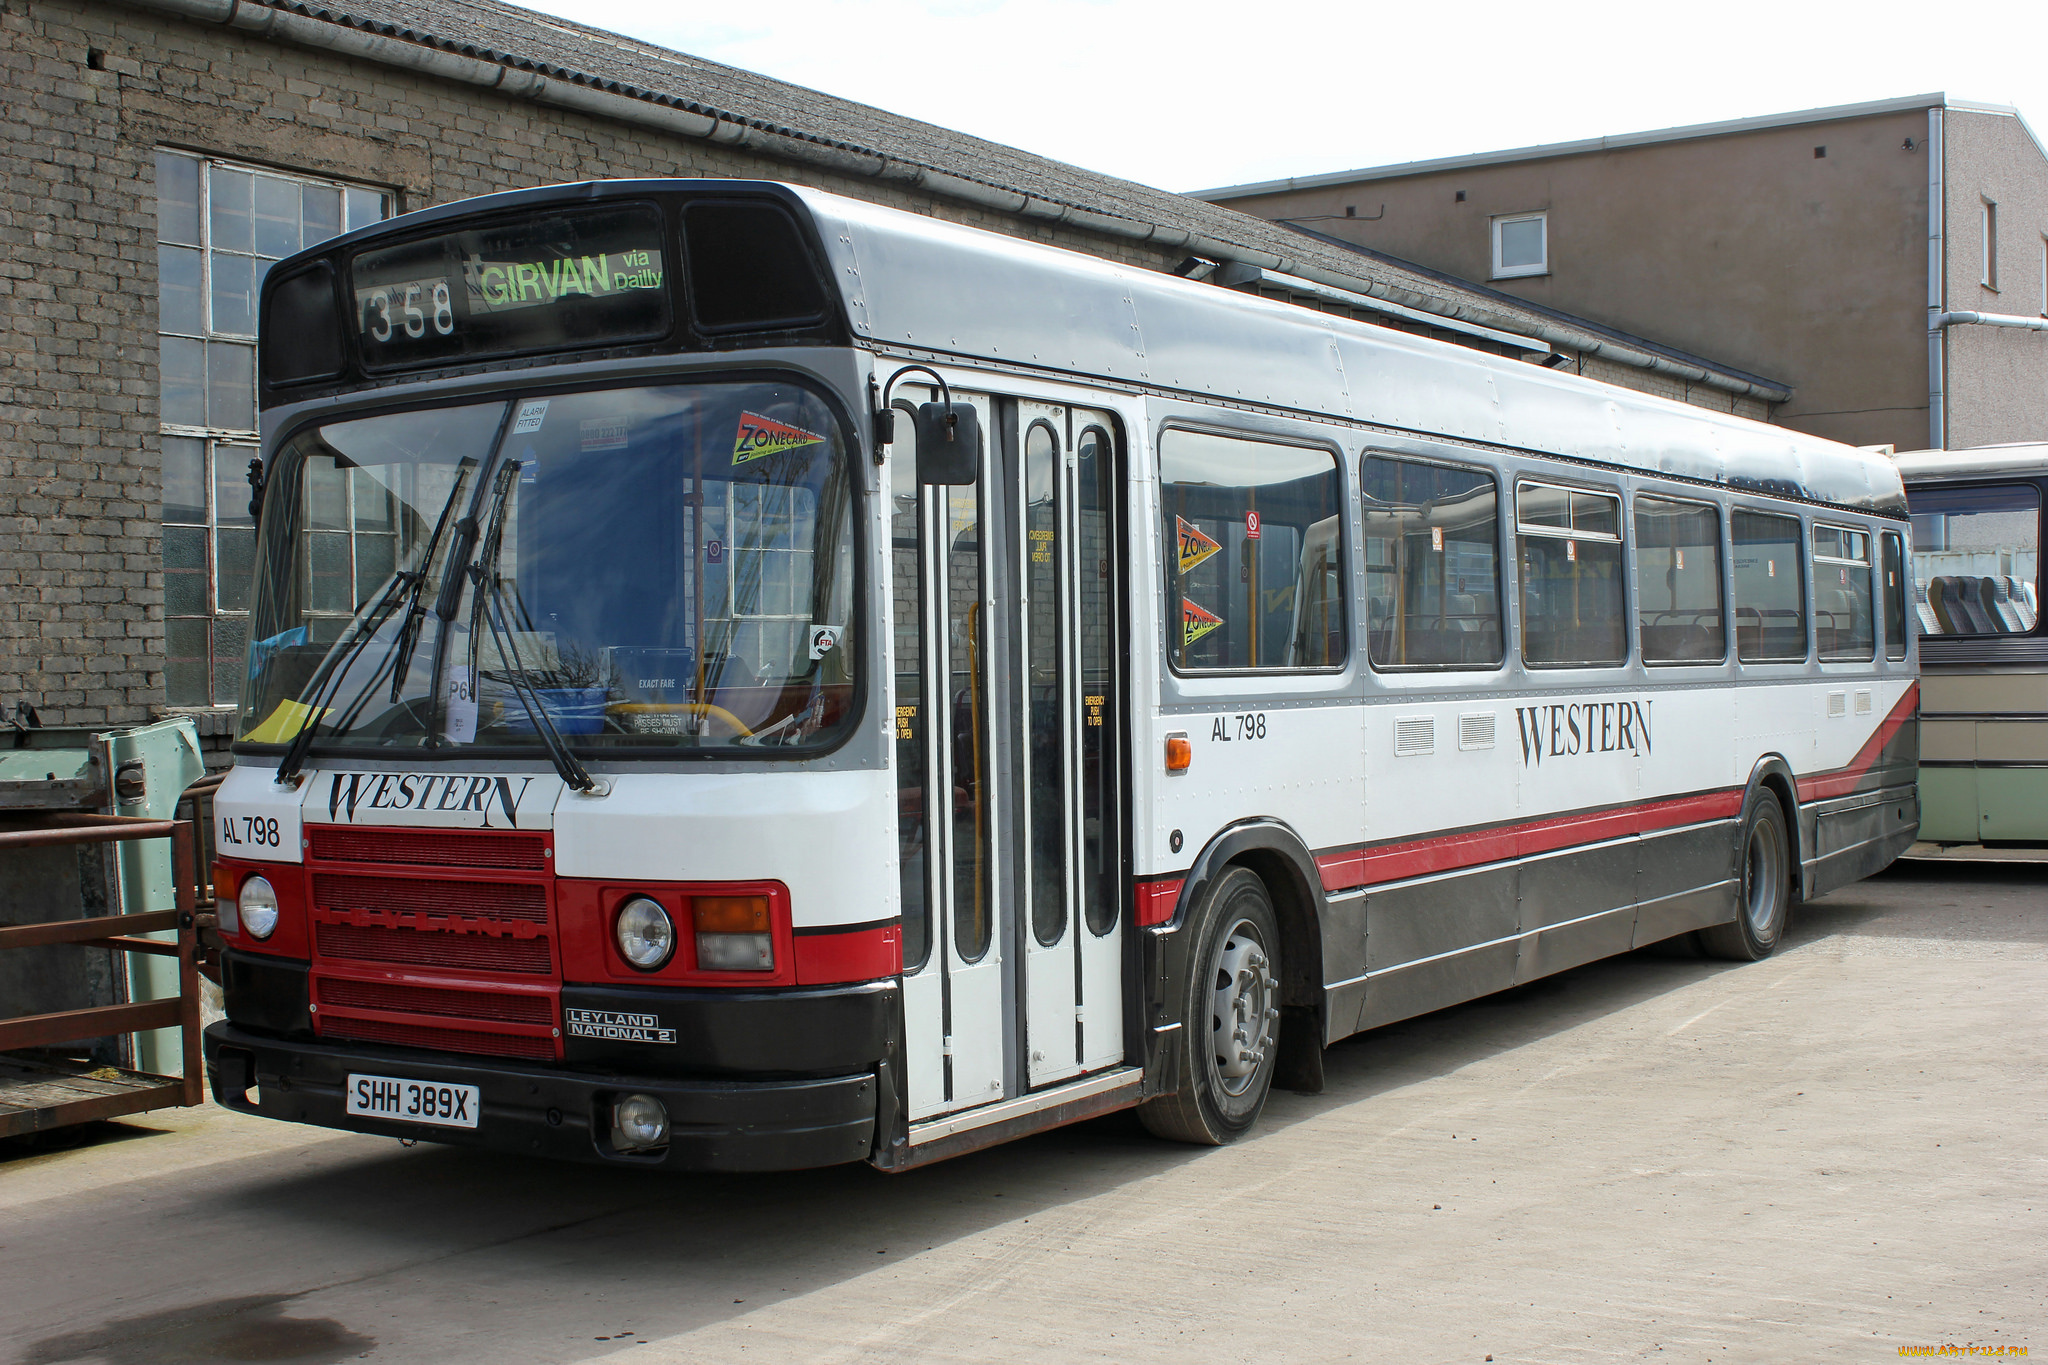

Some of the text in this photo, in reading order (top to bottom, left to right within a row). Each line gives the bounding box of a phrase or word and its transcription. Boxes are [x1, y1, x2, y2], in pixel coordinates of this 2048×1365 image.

[622, 249, 650, 268] via
[613, 268, 662, 290] Dailly
[370, 282, 454, 342] 358
[481, 253, 611, 306] GIRVAN
[517, 418, 541, 428] FITTED
[521, 406, 546, 417] ALARM
[736, 424, 808, 452] ZONECARD
[1185, 609, 1217, 635] ZONECARD
[639, 678, 676, 689] EXACT FARE
[634, 718, 682, 728] PASSES MUST
[1211, 713, 1266, 742] AL 798
[1515, 700, 1653, 770] WESTERN
[327, 773, 535, 829] WESTERN
[223, 815, 281, 848] AL 798
[570, 1010, 654, 1027] LEYLAND
[571, 1023, 671, 1041] NATIONAL 2
[357, 1079, 469, 1121] SHH 389X
